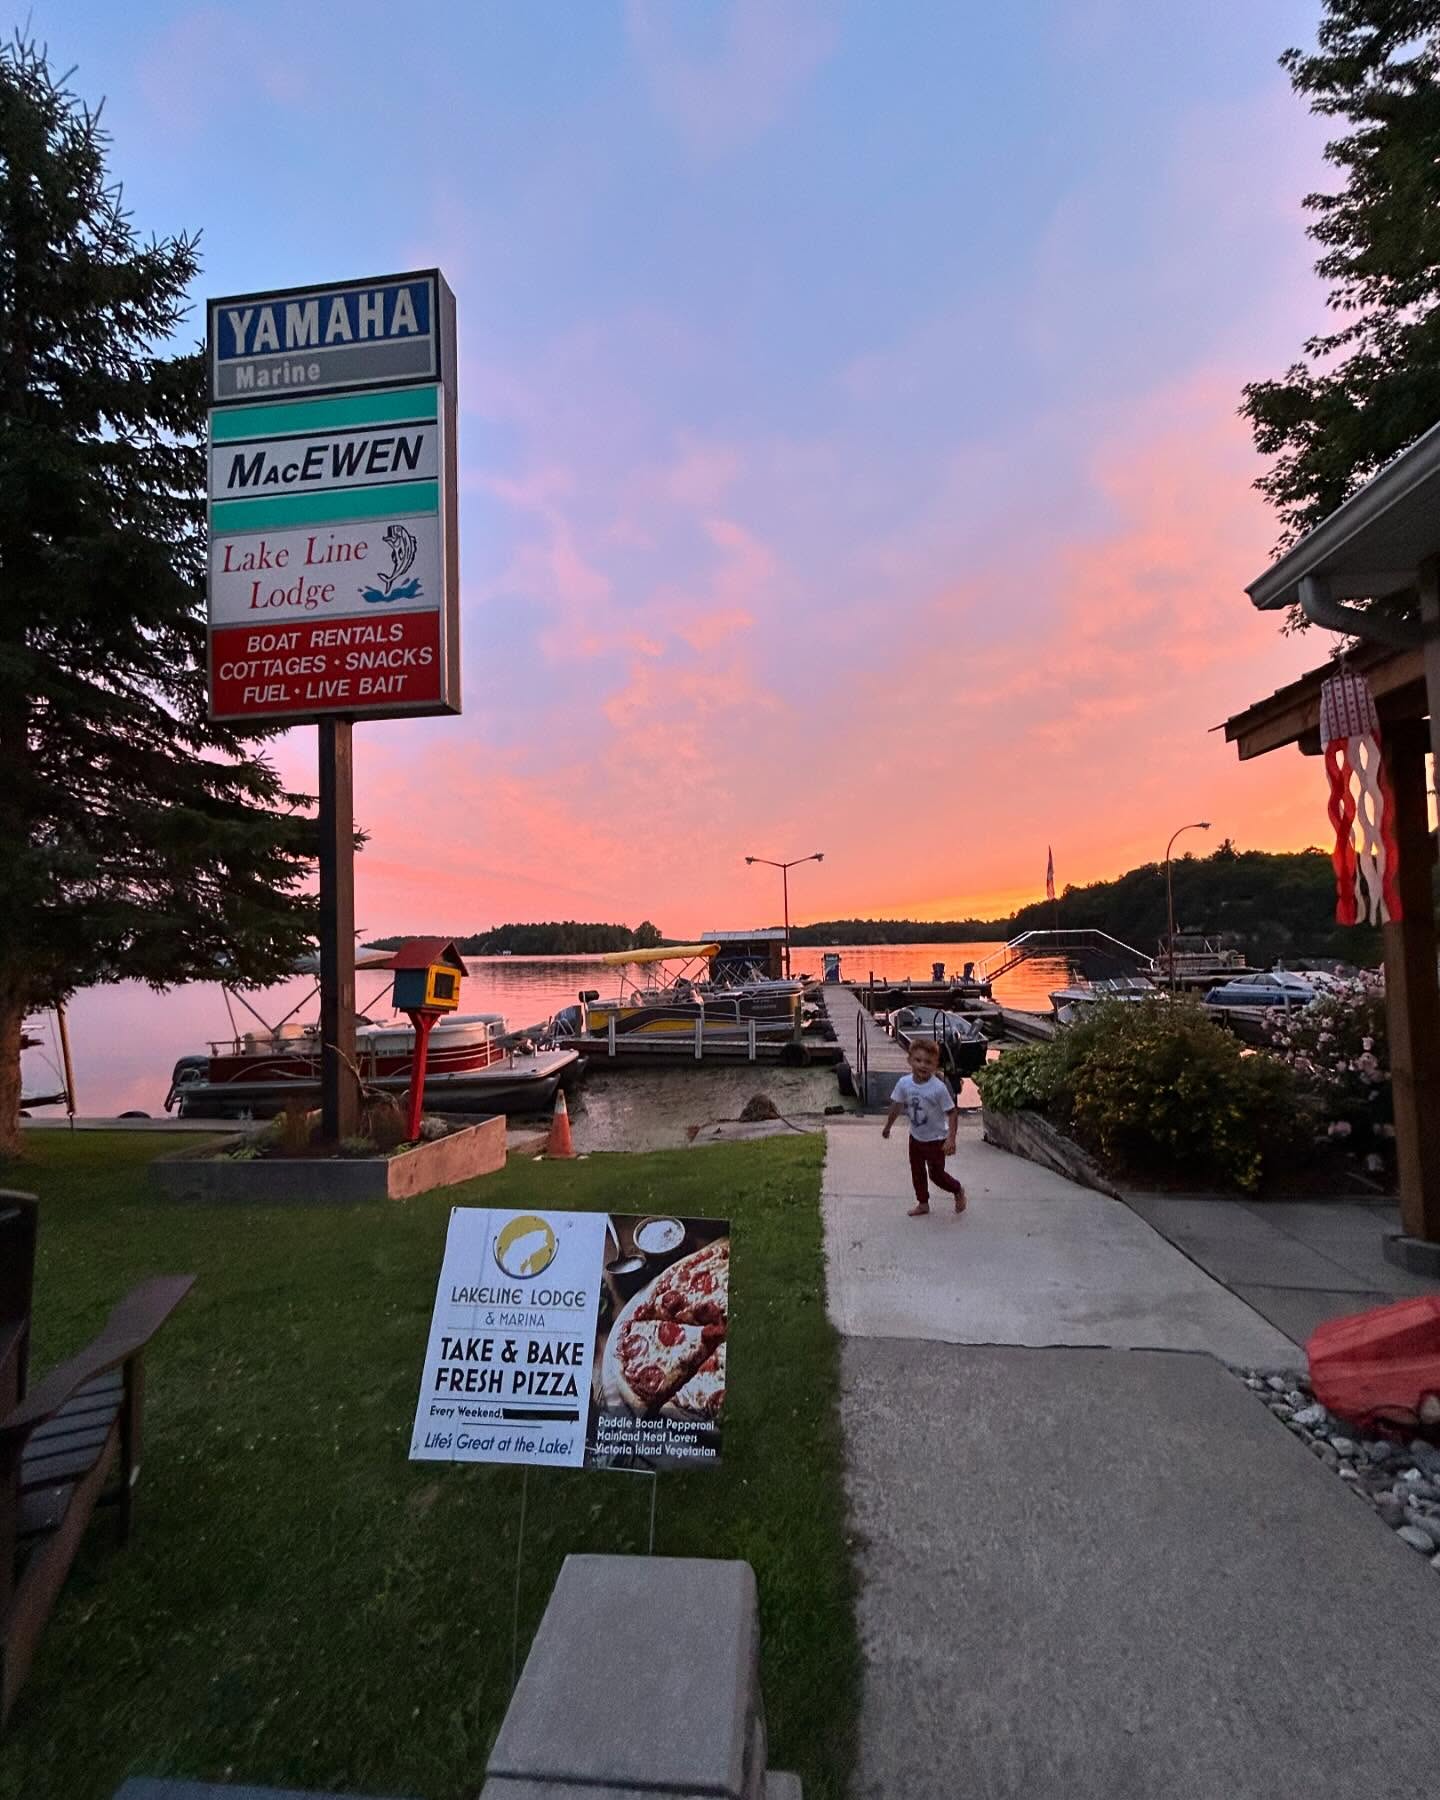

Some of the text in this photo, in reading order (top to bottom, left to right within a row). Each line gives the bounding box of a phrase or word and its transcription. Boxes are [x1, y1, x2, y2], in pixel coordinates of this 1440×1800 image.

[228, 288, 419, 354] YAMAHA
[236, 361, 321, 389] Marine
[221, 534, 369, 573] Lake Line
[249, 577, 335, 610] Lodge
[247, 624, 404, 653] BOAT RENTALS
[219, 647, 433, 681] COTTAGES SNACKS
[243, 675, 407, 704] FUEL LIVE BAIT
[451, 1287, 586, 1307] LAKELINE LODGE
[485, 1312, 545, 1328] & MARINA
[441, 1337, 584, 1365] TAKE & BAKE
[435, 1368, 579, 1397] FRESH PIZZA
[430, 1405, 455, 1418] Every
[598, 1416, 714, 1432] Paddle Board Pepperoni
[424, 1432, 574, 1455] Life's Great at the Lake!
[597, 1430, 697, 1443] Mainland Meat Lovers
[595, 1443, 716, 1459] Victoria Island Vegetarian
